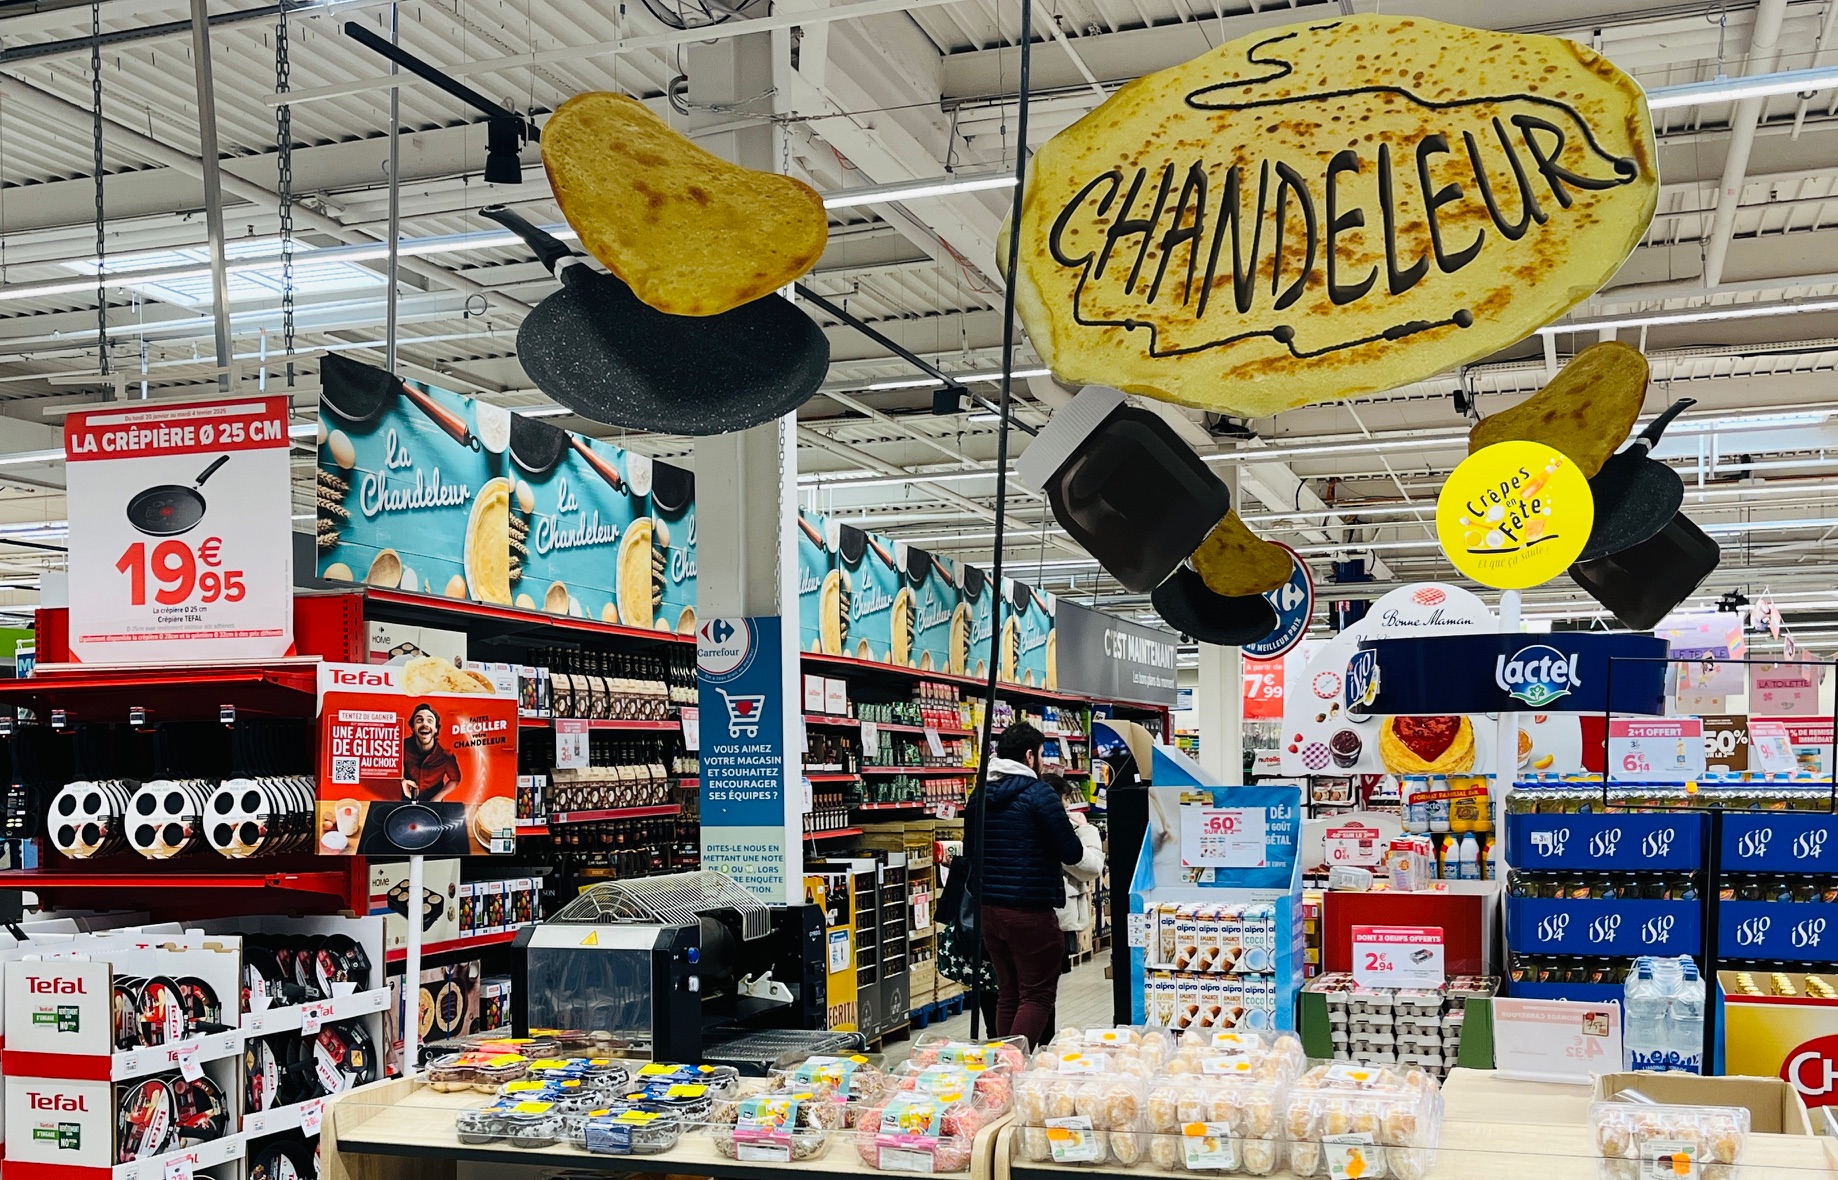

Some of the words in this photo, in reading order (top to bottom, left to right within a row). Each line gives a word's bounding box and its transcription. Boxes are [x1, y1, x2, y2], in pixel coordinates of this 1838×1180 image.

[1049, 113, 1637, 318] CHANDELEUR
[71, 433, 98, 453] LA
[102, 424, 195, 452] CRÊPIÈRE
[200, 425, 214, 446] Ø
[218, 422, 245, 443] 25
[249, 420, 282, 441] CM
[385, 427, 412, 470] La
[360, 466, 470, 517] Chandeleur
[557, 477, 578, 513] La
[1467, 466, 1530, 518] Crêpes
[1506, 498, 1516, 508] en
[1498, 498, 1541, 542] Fête
[536, 510, 620, 554] Chandeleur
[852, 585, 892, 620] Chandeleur
[184, 614, 202, 622] TEFAL
[918, 601, 952, 634] Chandeleur
[1382, 608, 1422, 627] Bonne
[1422, 609, 1474, 626] Maman
[1257, 634, 1289, 652] MEILLEUR
[1288, 616, 1302, 636] PRIX
[697, 648, 740, 658] Carrefour
[1104, 628, 1127, 660] C'EST
[1128, 634, 1174, 669] MAINTENANT
[1673, 650, 1685, 659] LE
[329, 668, 394, 688] Tefal
[1758, 680, 1771, 688] LA
[1772, 680, 1810, 688] TOILETTE
[342, 712, 362, 720] TENTEZ
[470, 715, 489, 723] FAITES
[333, 726, 354, 739] UNE
[355, 726, 400, 740] ACTIVITÉ
[452, 720, 507, 735] DÉCOLLER
[1628, 728, 1644, 736] 2+1
[1646, 728, 1682, 736] OFFERT
[333, 739, 350, 755] DE
[353, 740, 400, 757] GLISSE
[453, 736, 506, 749] CHANDELEUR
[714, 745, 740, 754] VOUS
[742, 744, 772, 754] AIMEZ
[361, 757, 372, 767] AU
[704, 756, 736, 766] VOTRE
[738, 755, 782, 765] MAGASIN
[708, 768, 720, 777] ET
[722, 767, 778, 777] SOUHAITEZ
[709, 779, 778, 790] ENCOURAGER
[709, 791, 727, 800] SES
[728, 789, 770, 802] ÉQUIPES
[772, 791, 778, 800] ?
[1271, 822, 1290, 832] GOÛT
[1266, 834, 1291, 845] GÉTAL
[746, 875, 783, 884] ENQUÊTE
[1199, 925, 1218, 934] alpro
[1221, 925, 1241, 934] alpro
[1244, 926, 1264, 934] alpro
[1245, 936, 1264, 944] COCO
[26, 977, 87, 994] Tefal
[1156, 982, 1175, 990] alpro
[1178, 983, 1198, 991] alpro
[1200, 984, 1220, 992] alpro
[1222, 985, 1242, 993] alpro
[1245, 986, 1265, 995] alpro
[829, 1002, 856, 1028] EGRITA
[26, 1092, 88, 1112] Tefal
